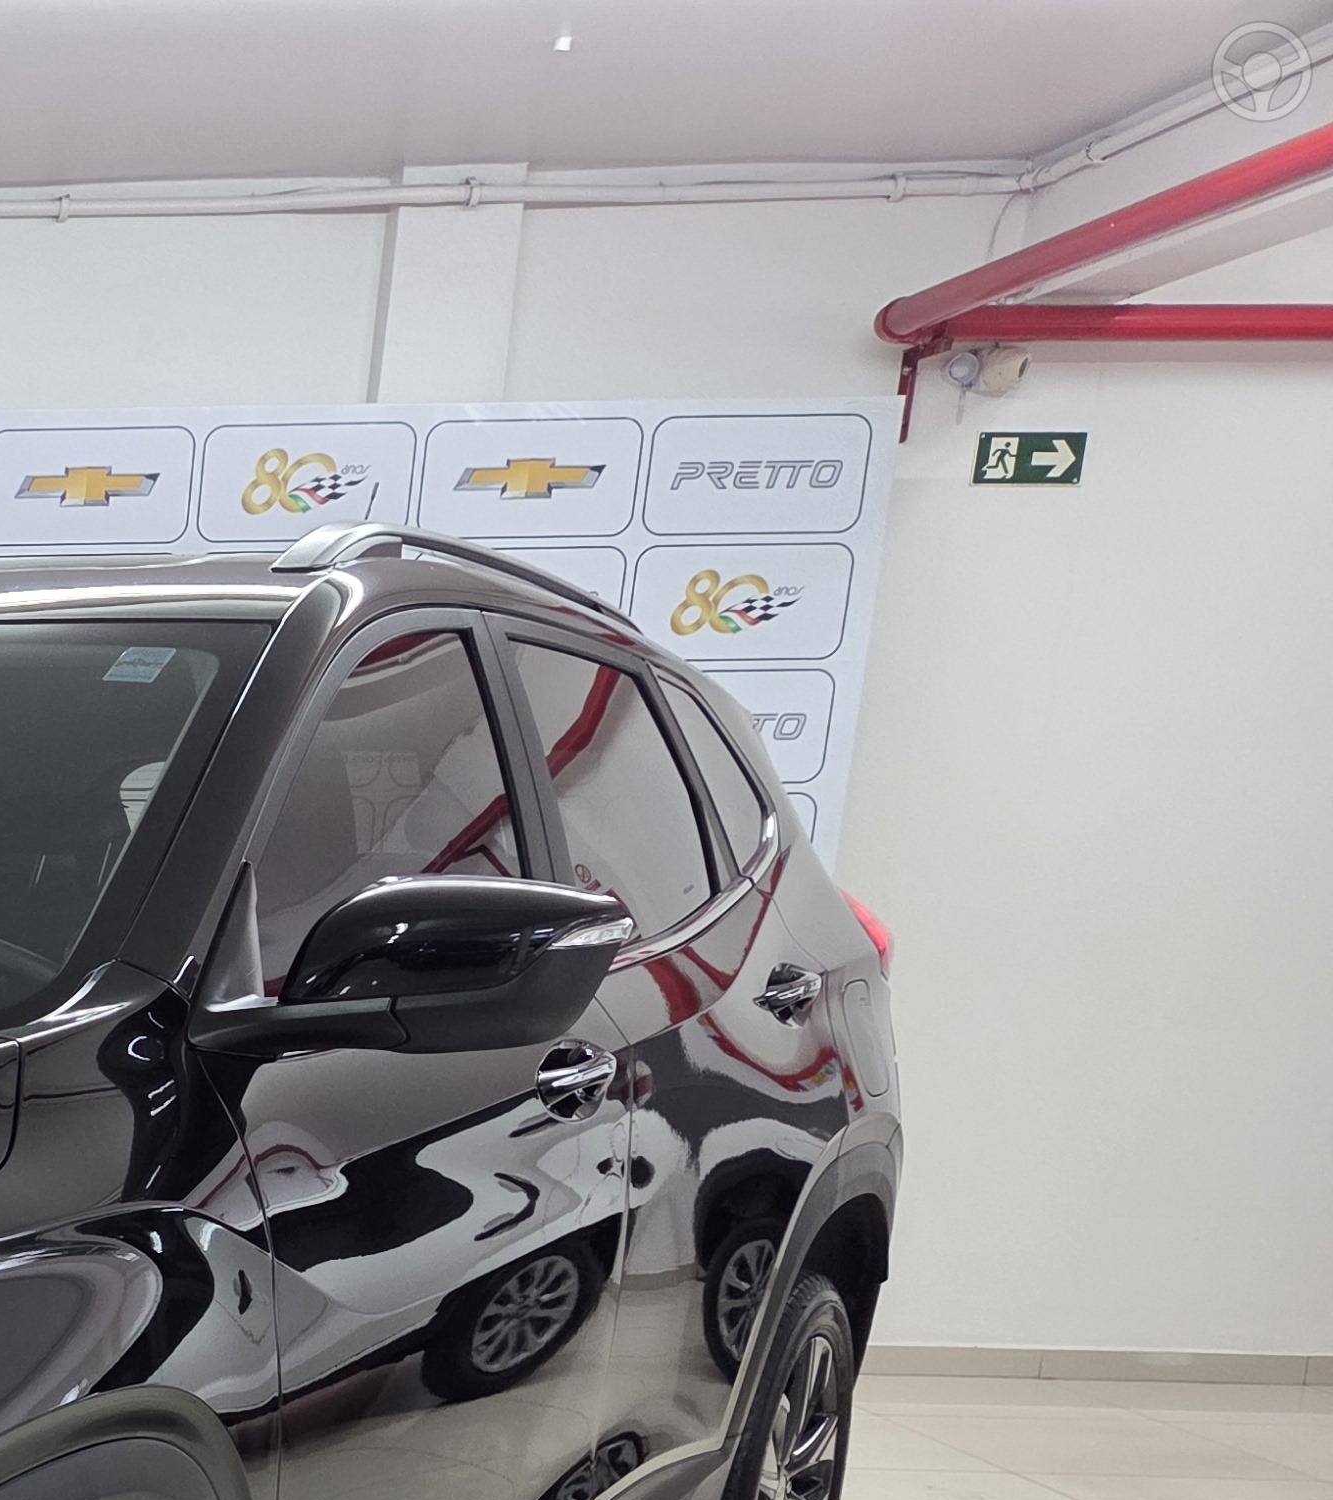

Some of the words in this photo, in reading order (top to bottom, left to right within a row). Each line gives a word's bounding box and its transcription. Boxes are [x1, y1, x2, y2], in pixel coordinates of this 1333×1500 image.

[241, 448, 337, 515] 80
[670, 459, 844, 491] PRETTO
[670, 569, 770, 636] 80
